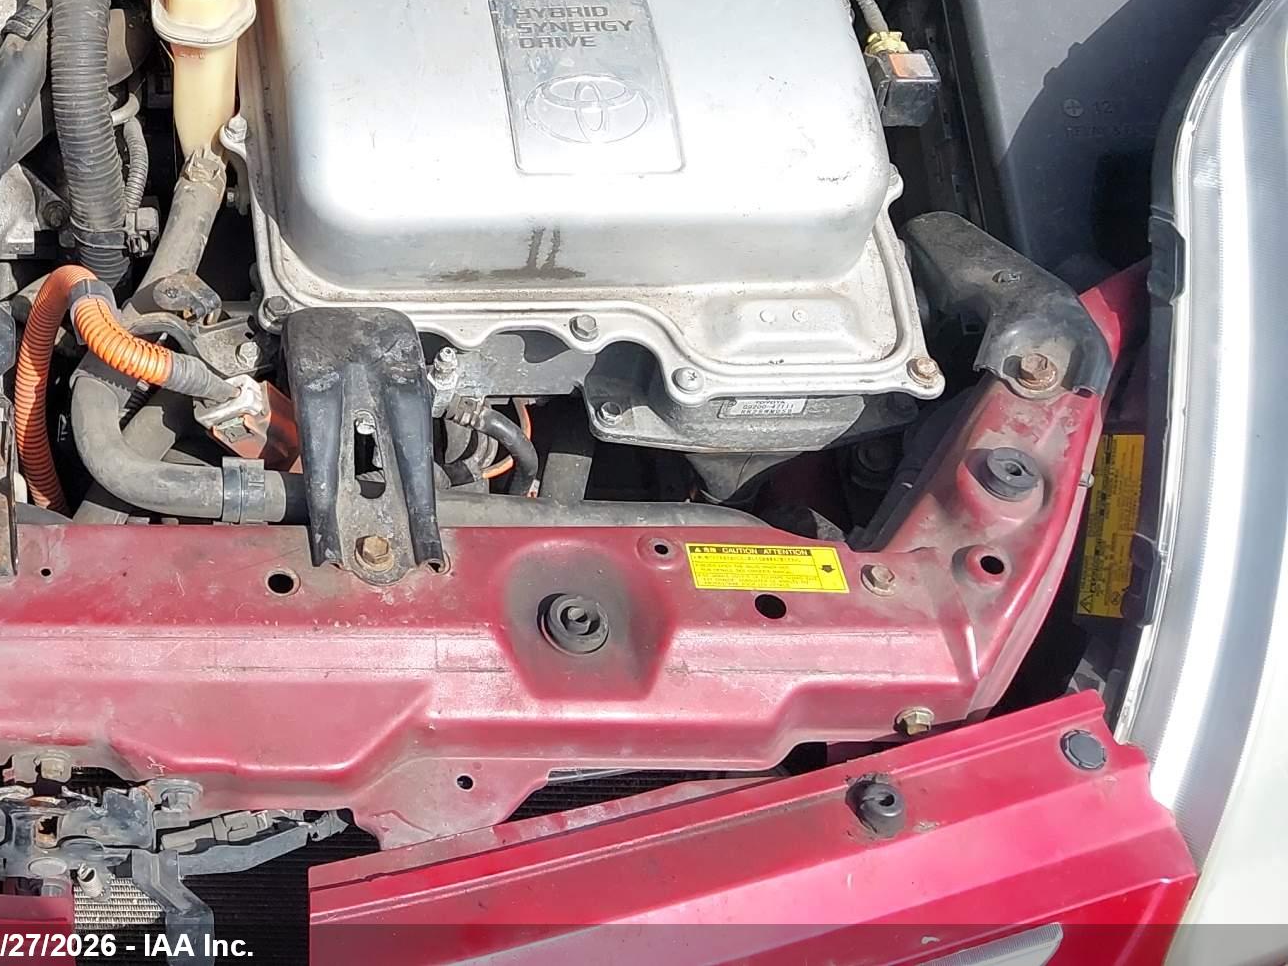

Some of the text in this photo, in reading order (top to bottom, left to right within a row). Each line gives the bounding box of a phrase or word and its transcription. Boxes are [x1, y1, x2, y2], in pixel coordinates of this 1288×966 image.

[513, 5, 609, 19] HYBRID
[516, 20, 634, 34] SYNERGY
[519, 36, 597, 49] DRIVE
[721, 547, 759, 555] CAUTION
[763, 548, 809, 556] ATTENTION
